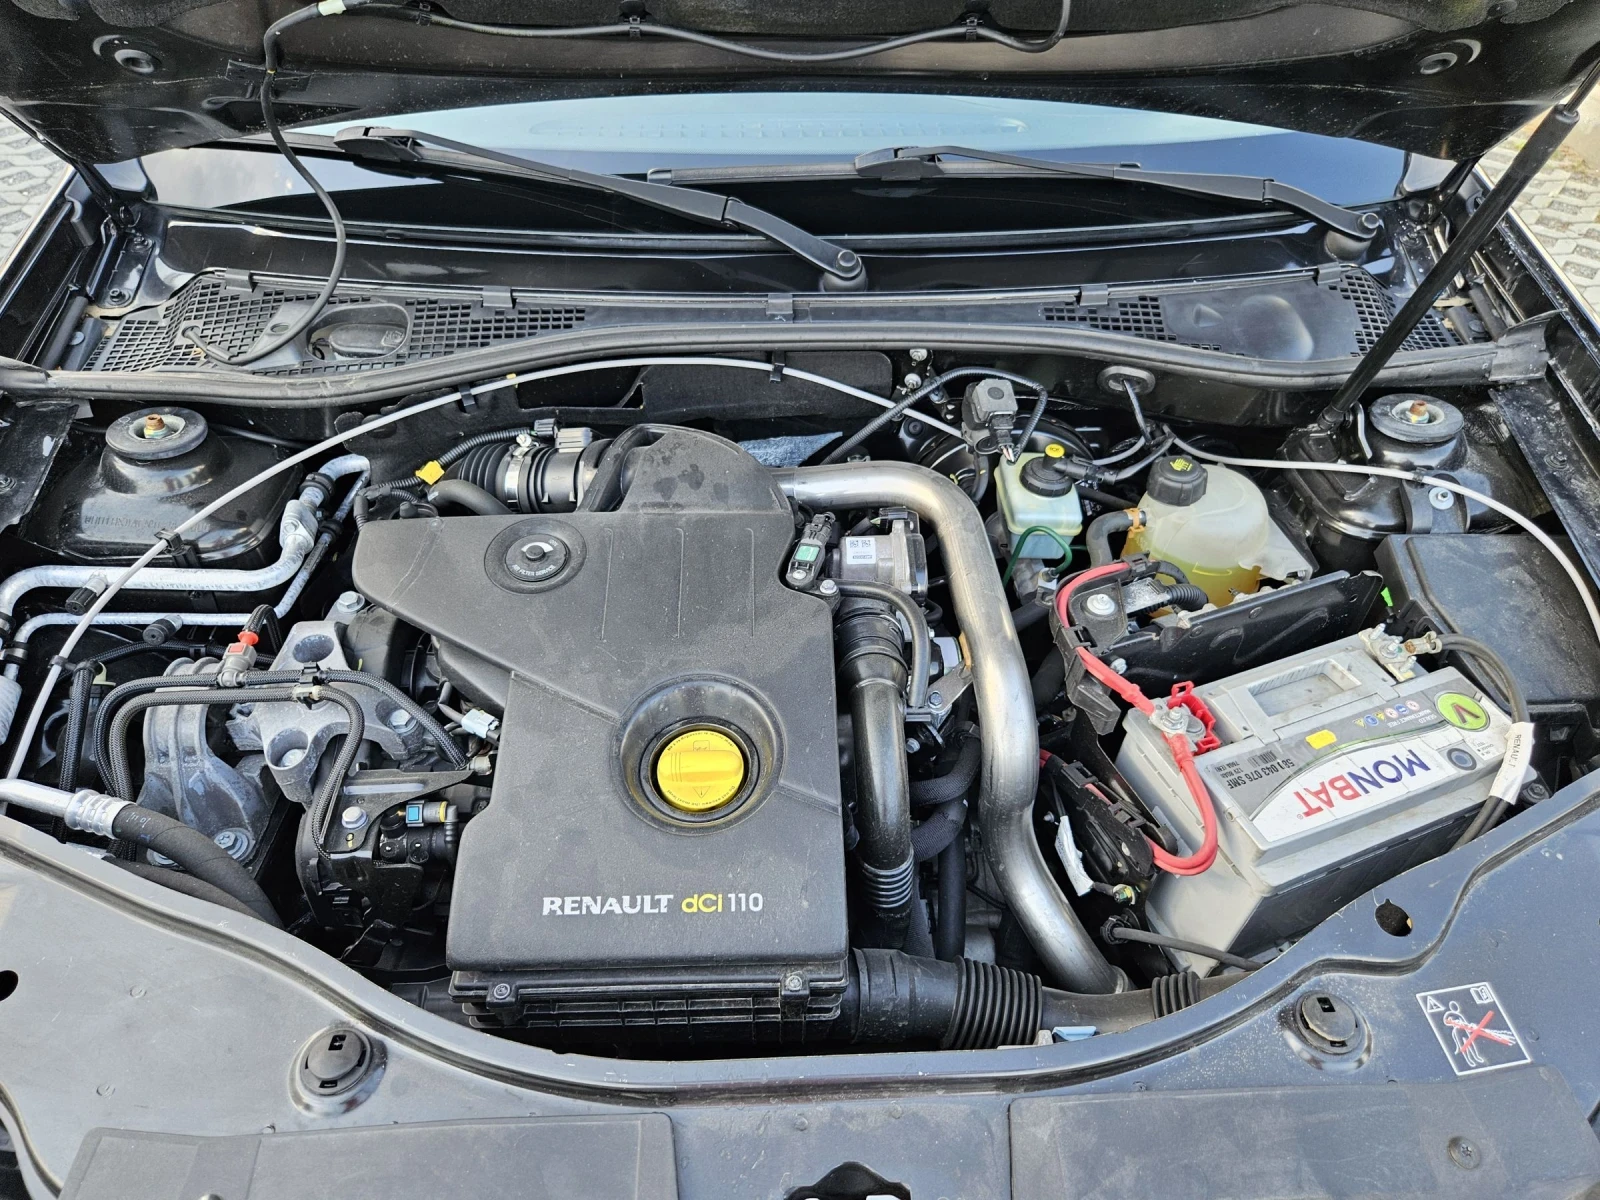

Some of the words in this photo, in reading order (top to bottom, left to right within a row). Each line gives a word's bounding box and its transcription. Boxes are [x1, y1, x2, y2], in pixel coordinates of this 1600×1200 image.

[536, 564, 556, 576] SERVICE
[1244, 770, 1262, 782] 076
[1262, 764, 1279, 776] 043
[1226, 776, 1246, 790] SMF
[1294, 750, 1431, 817] MONBAT
[542, 895, 674, 916] RENAULT
[682, 894, 723, 913] dCi
[728, 893, 764, 912] 110
